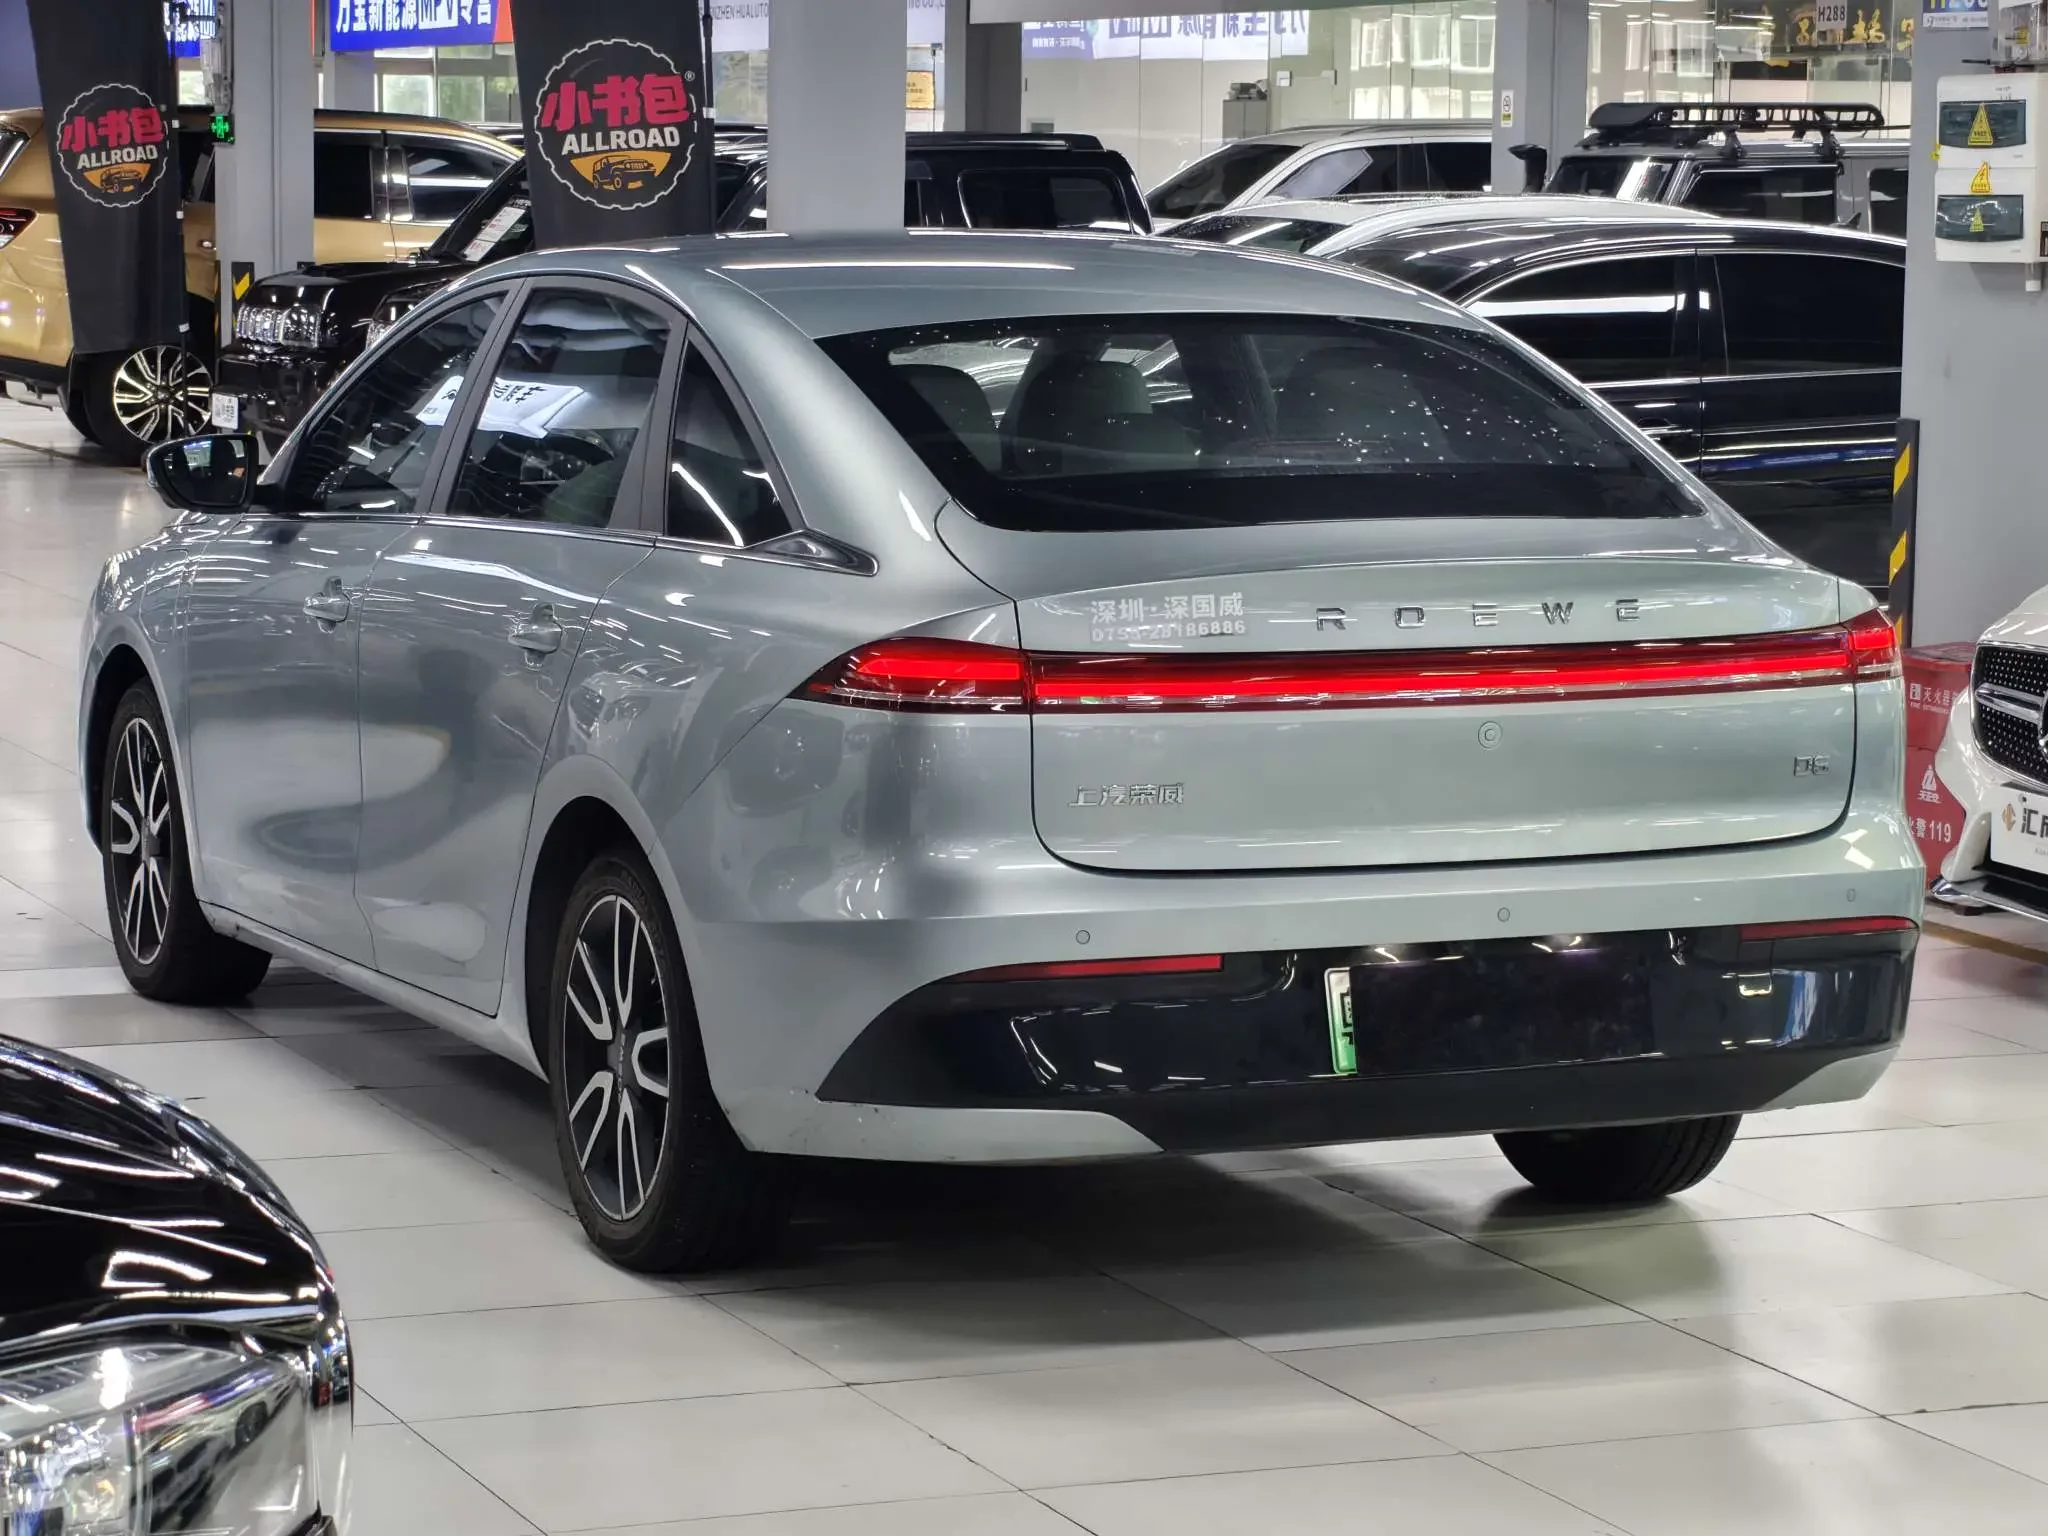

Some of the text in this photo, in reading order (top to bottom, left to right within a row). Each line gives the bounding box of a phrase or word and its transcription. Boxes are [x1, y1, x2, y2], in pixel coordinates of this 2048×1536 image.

[1817, 5, 1846, 22] H288
[540, 73, 690, 132] 小书包
[61, 107, 164, 153] 小书包
[561, 126, 680, 155] ALLROAD
[77, 144, 158, 169] ALLROAD
[1316, 598, 1641, 632] ROEWE
[1067, 782, 1185, 807] 上汽荣威
[1929, 819, 1952, 844] 119
